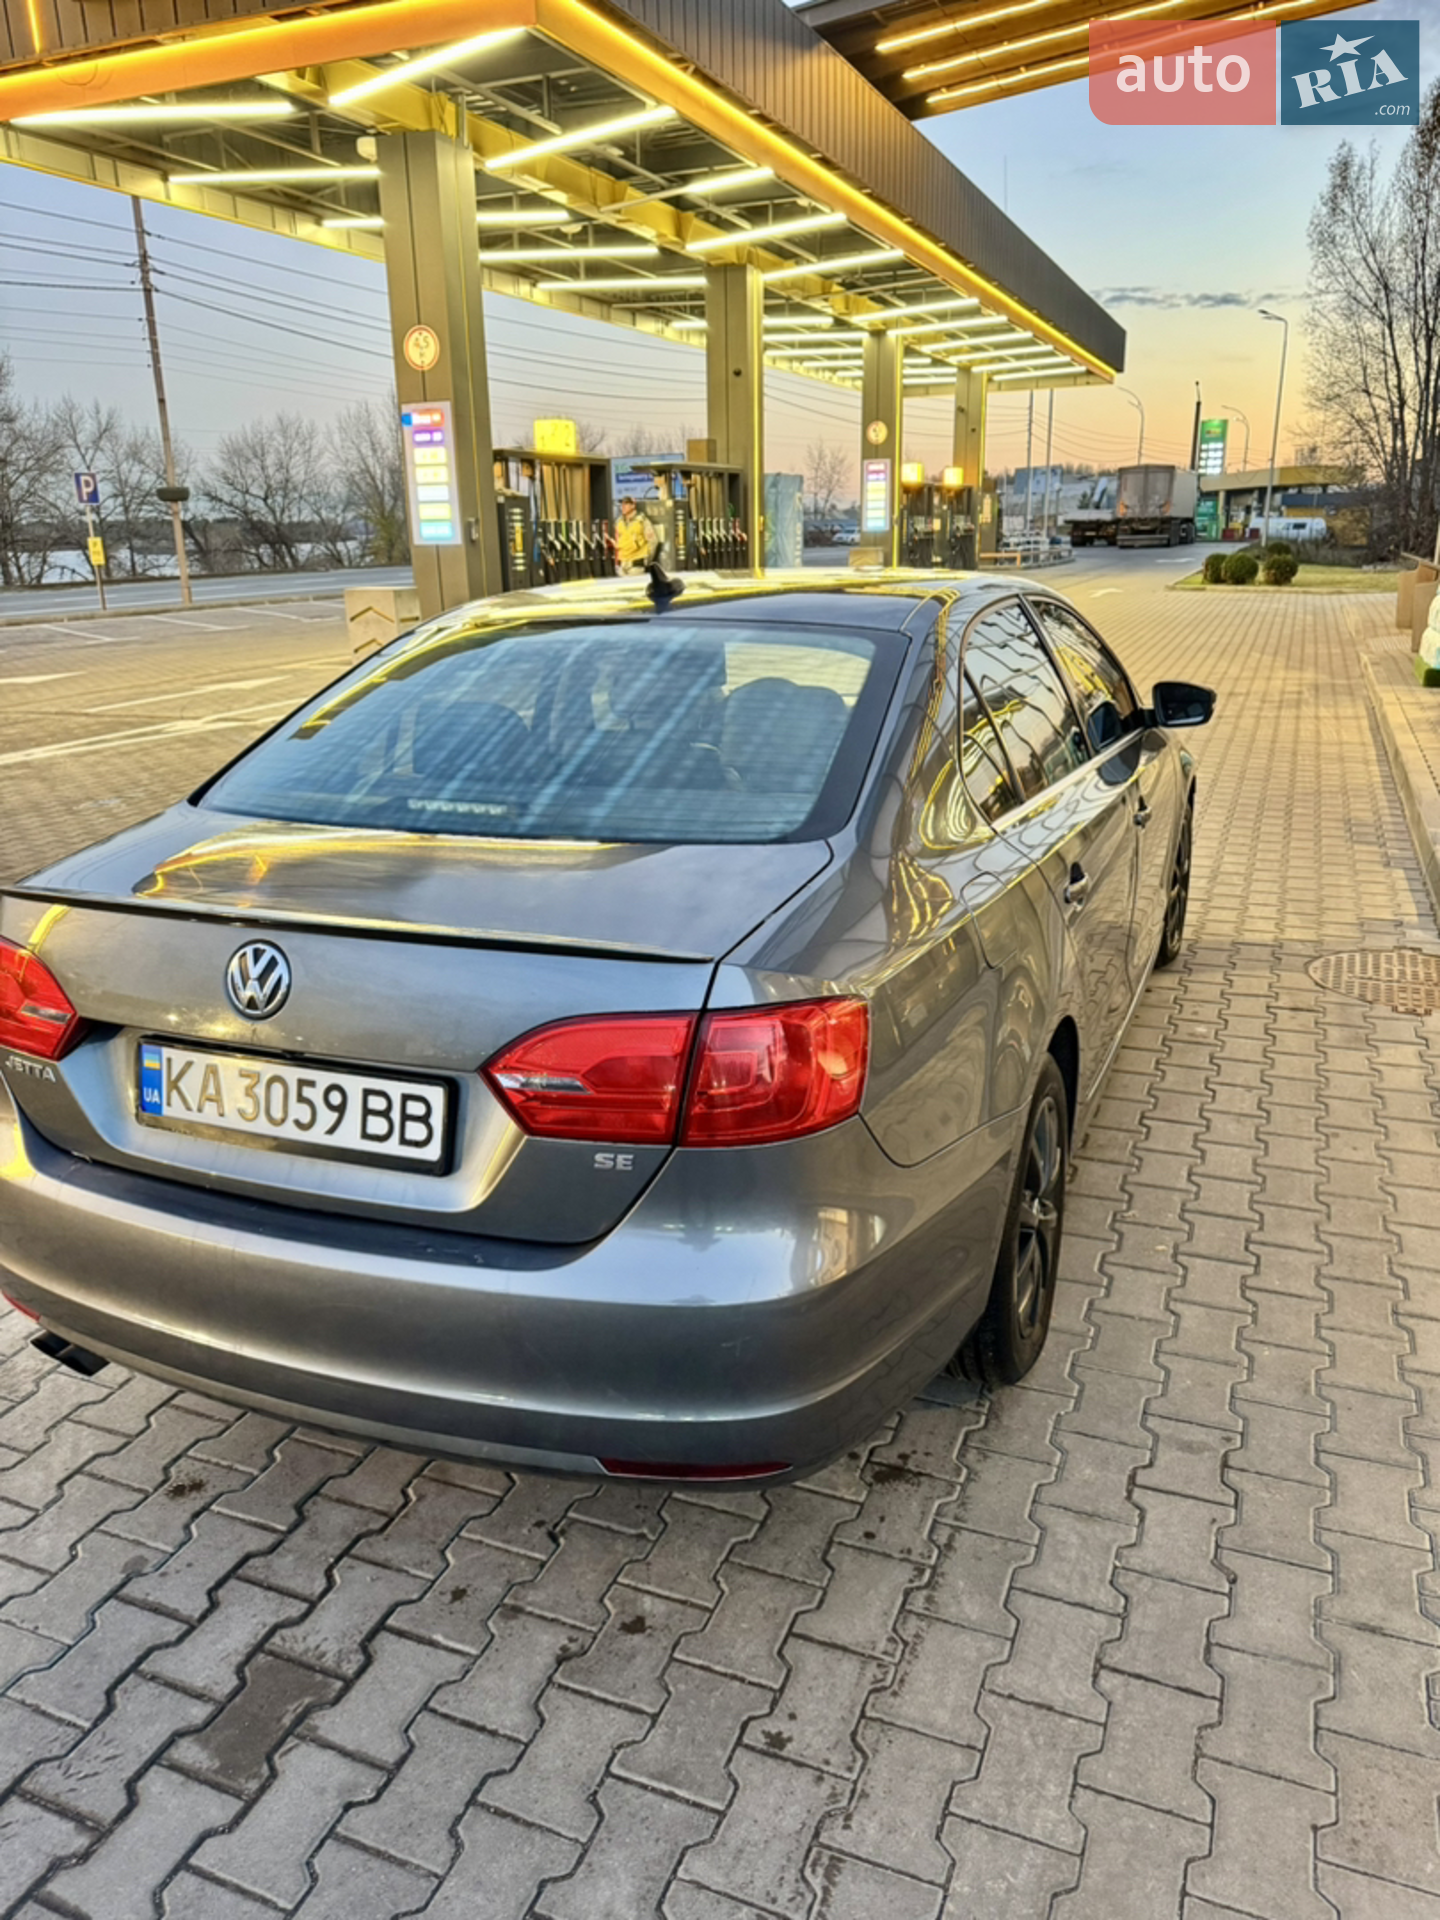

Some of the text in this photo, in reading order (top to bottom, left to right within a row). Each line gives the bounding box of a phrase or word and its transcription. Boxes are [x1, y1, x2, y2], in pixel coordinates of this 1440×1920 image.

[80, 475, 95, 501] P
[143, 1086, 161, 1104] UA
[165, 1057, 434, 1149] KA 3059 BB
[594, 1153, 635, 1170] SE
